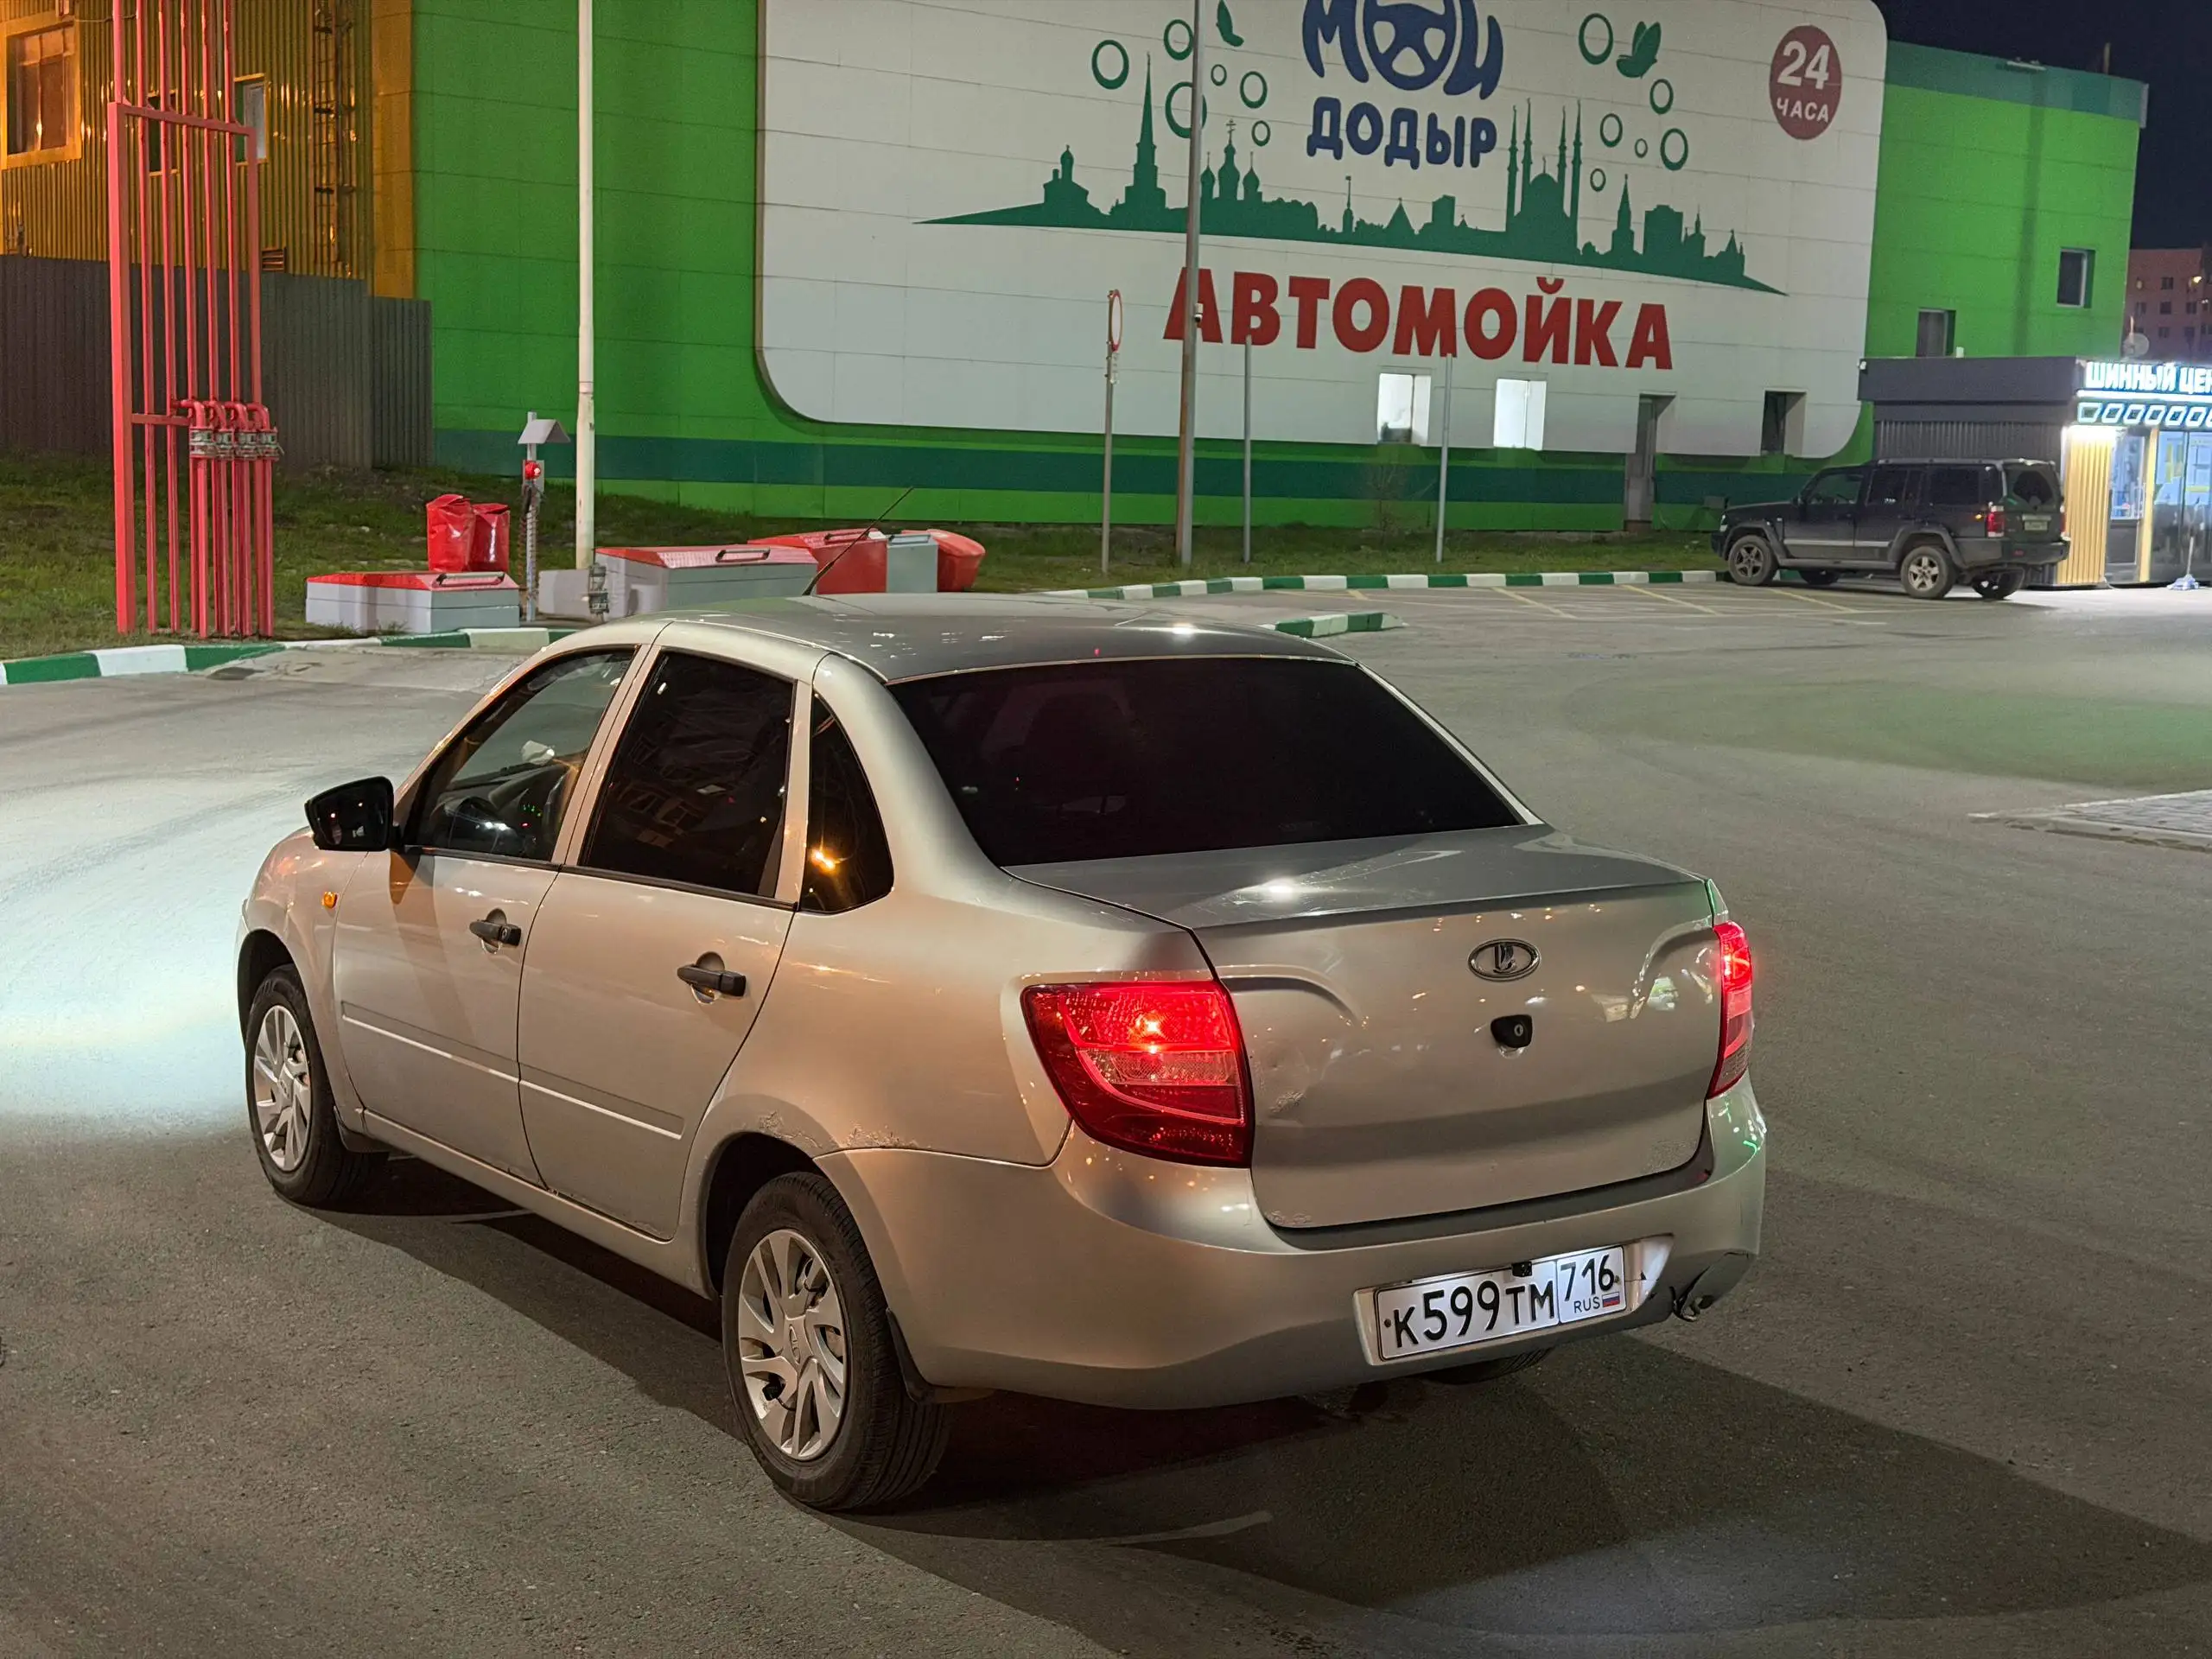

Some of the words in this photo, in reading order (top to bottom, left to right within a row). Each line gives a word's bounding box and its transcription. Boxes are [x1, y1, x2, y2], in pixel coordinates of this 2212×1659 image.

[1777, 40, 1830, 90] 24
[1306, 96, 1497, 170] ДОДЫР
[1776, 97, 1829, 123] ЧАСА
[1163, 266, 1673, 370] АВТОМОЙКА
[2085, 361, 2177, 391] ШИННЫЙ
[1560, 1254, 1614, 1302] 716
[1573, 1296, 1600, 1313] RUS
